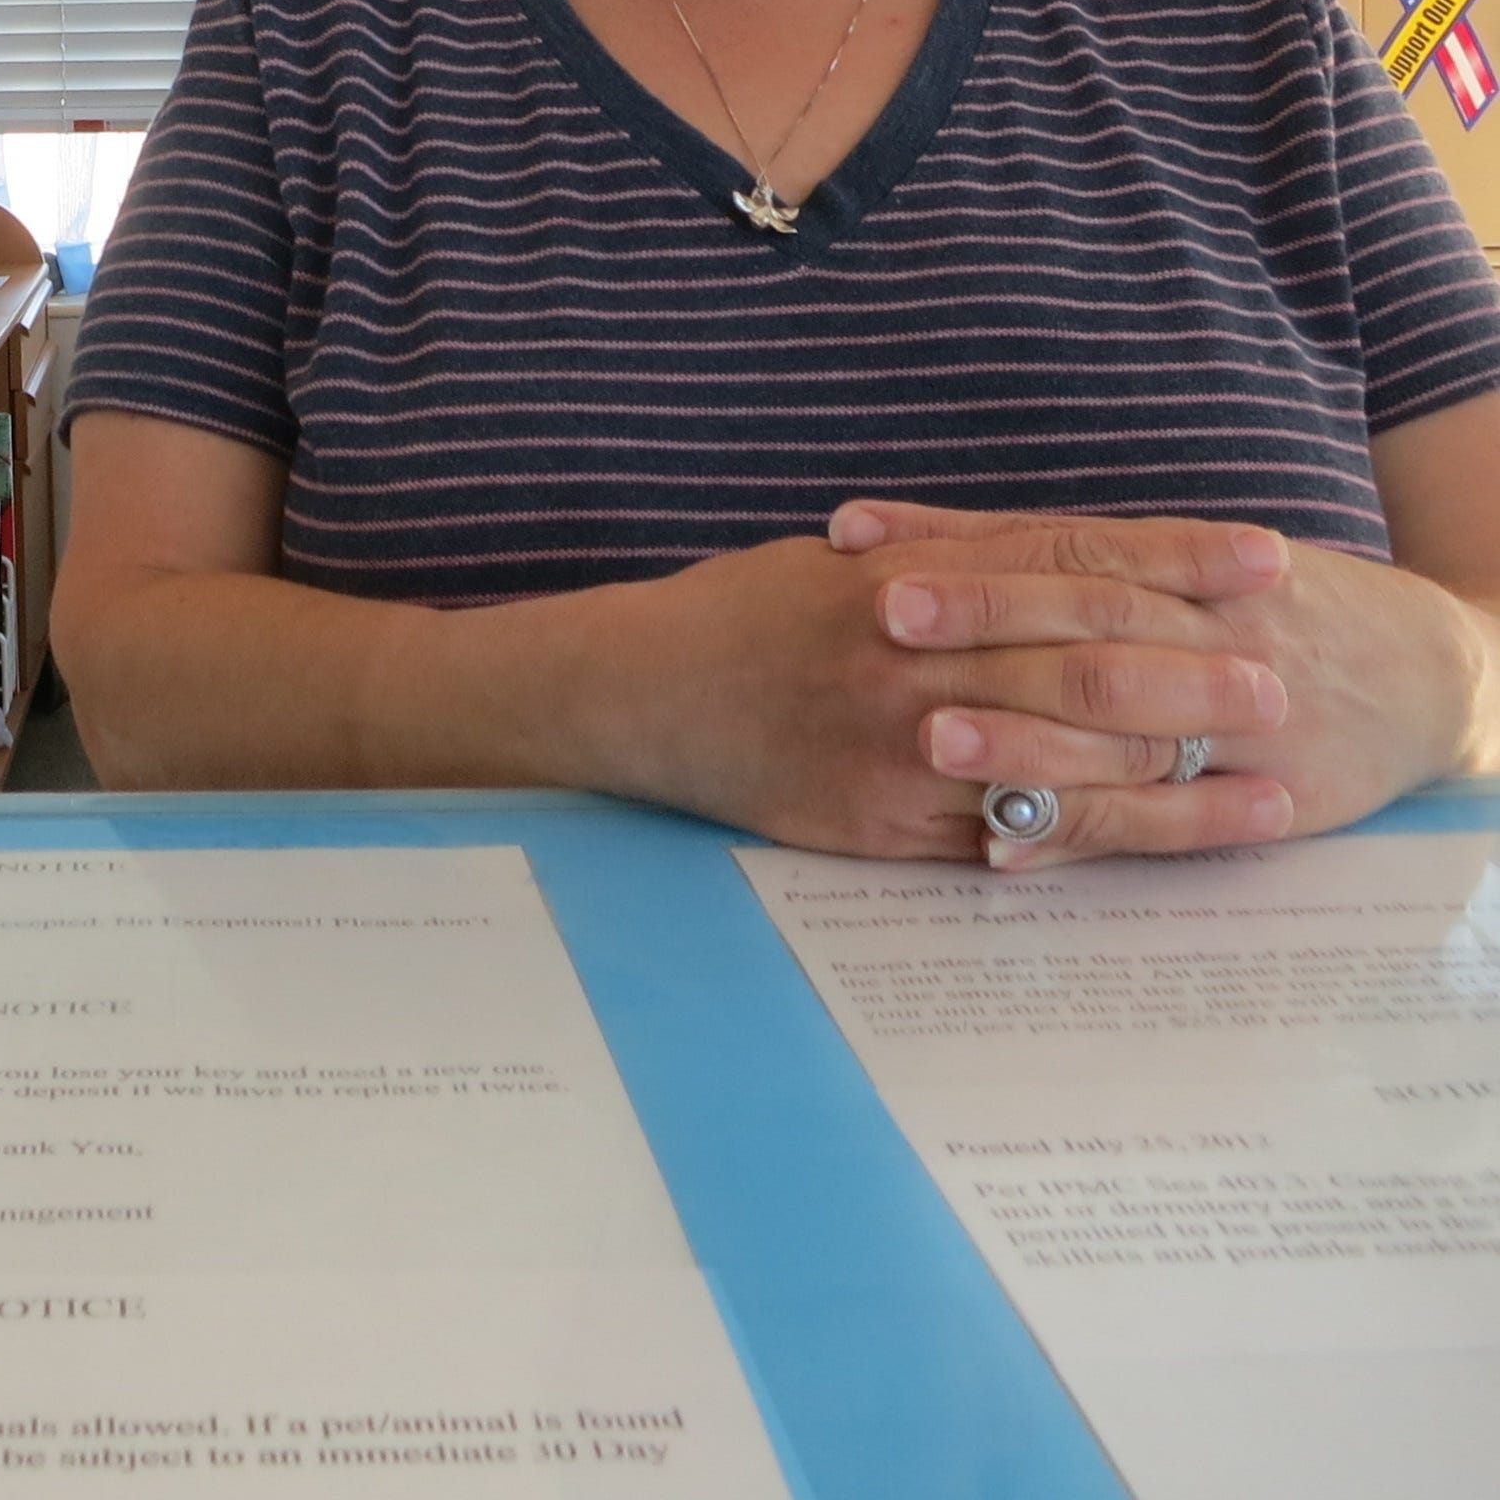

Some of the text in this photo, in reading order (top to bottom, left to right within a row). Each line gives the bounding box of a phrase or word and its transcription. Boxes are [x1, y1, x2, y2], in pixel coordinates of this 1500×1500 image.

[1388, 22, 1436, 86] upport
[783, 883, 1064, 901] Posted April 2016
[115, 917, 153, 927] No
[333, 917, 413, 927] Please
[422, 916, 489, 927] don't
[803, 907, 1162, 930] Effective on April 2016
[51, 1066, 107, 1079] lose
[118, 1068, 183, 1082] your
[194, 1066, 242, 1080] key
[257, 1066, 307, 1079] and
[319, 1065, 386, 1079] need
[421, 1066, 480, 1077] new
[14, 1086, 118, 1102] deposit
[162, 1086, 203, 1097] we
[213, 1084, 283, 1097] have
[294, 1086, 322, 1097] to
[333, 1083, 440, 1100] replace
[479, 1081, 570, 1093] twice.
[1372, 1080, 1500, 1102] NOTIC
[71, 1139, 143, 1157] You,
[943, 1138, 1052, 1156] Posted
[1061, 1135, 1123, 1155] July
[974, 1180, 1025, 1198] Per
[1007, 1222, 1167, 1248] permitted
[72, 1412, 231, 1437] allowed.
[245, 1412, 276, 1434] If
[288, 1420, 307, 1434] a
[321, 1409, 517, 1440] pet/animal
[531, 1409, 561, 1431] is
[576, 1406, 684, 1431] found
[0, 1448, 39, 1468] be
[58, 1447, 195, 1474] subject
[208, 1448, 244, 1467] to
[258, 1450, 302, 1467] an
[318, 1443, 517, 1466] immediate
[533, 1442, 579, 1463] 30
[590, 1441, 669, 1468] Day
